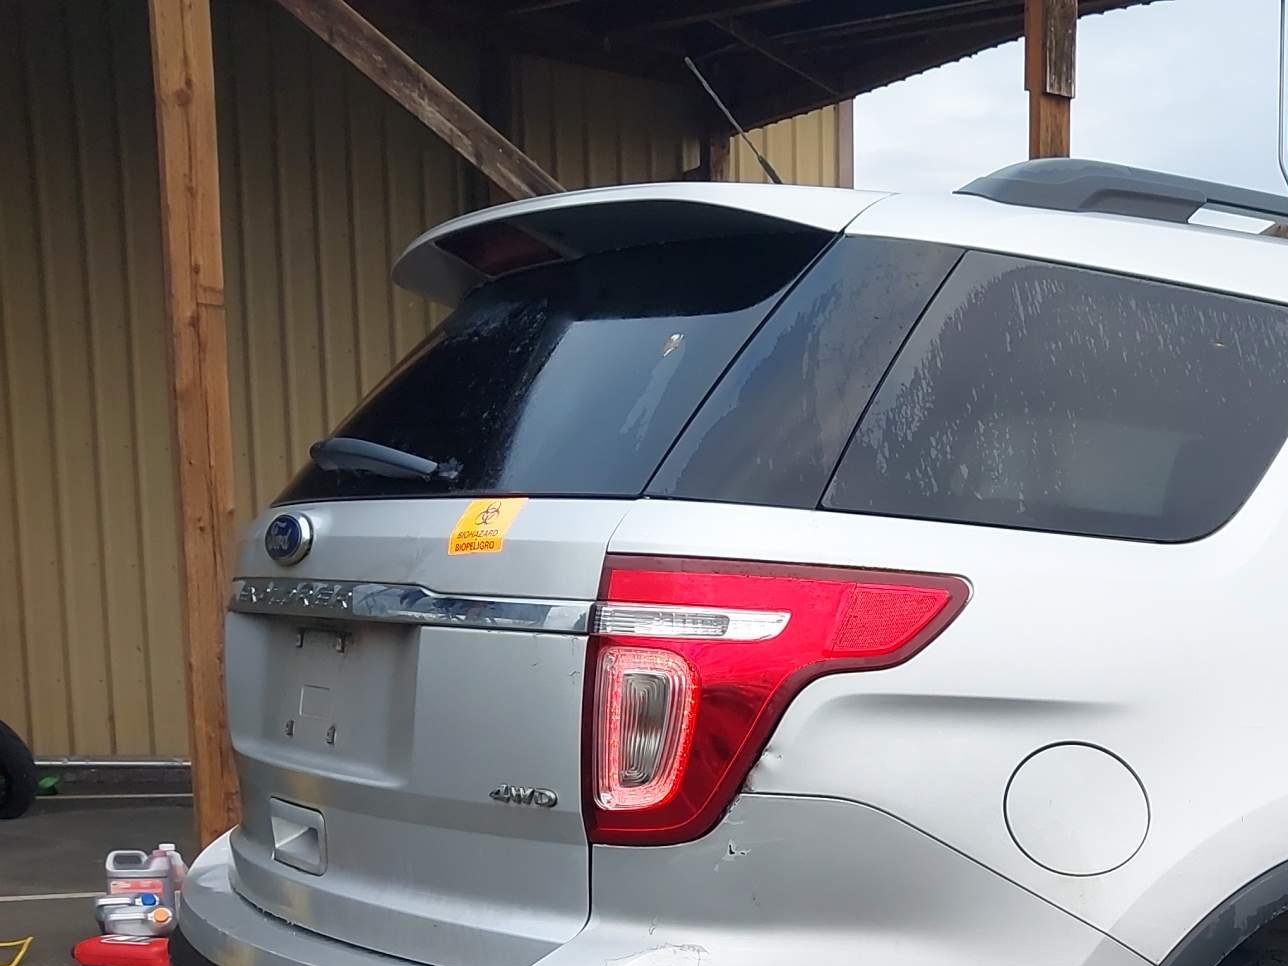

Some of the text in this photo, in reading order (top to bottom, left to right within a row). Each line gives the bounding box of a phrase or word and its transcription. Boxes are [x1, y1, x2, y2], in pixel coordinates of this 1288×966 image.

[269, 520, 293, 551] Ford
[456, 529, 499, 539] BIOHAZARD
[455, 540, 495, 552] BIOPELIGRO
[489, 782, 558, 808] 4WD
